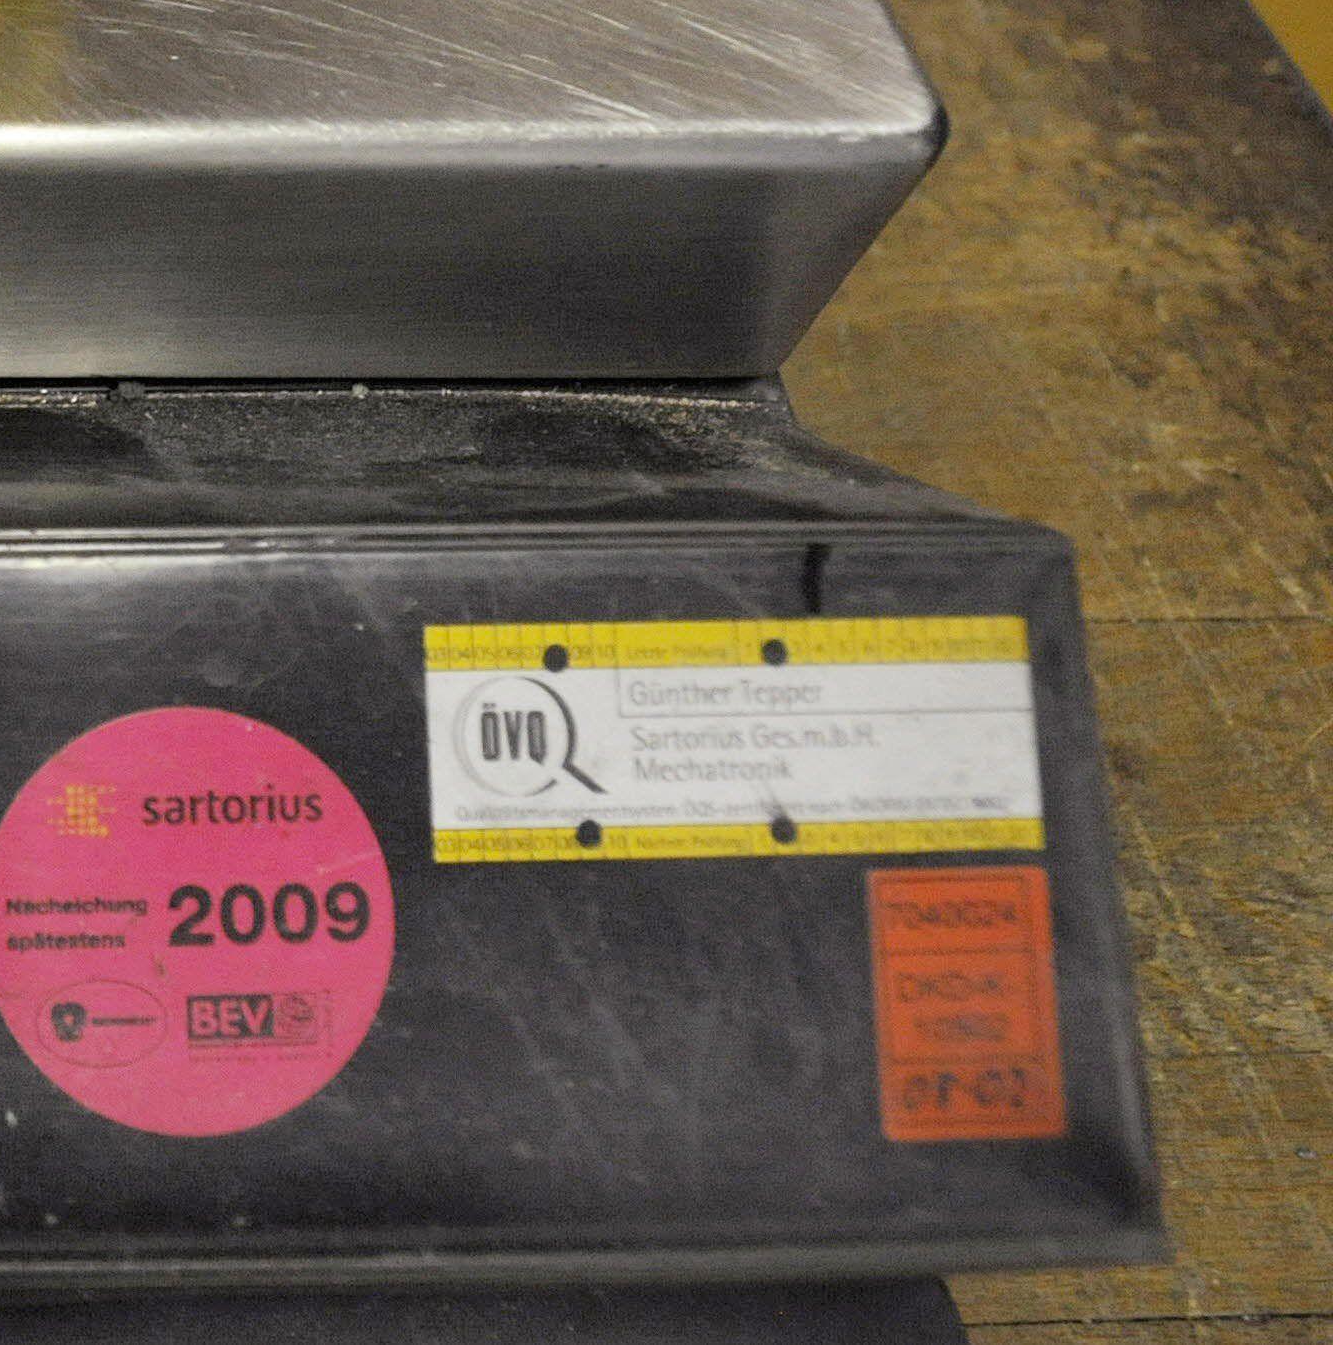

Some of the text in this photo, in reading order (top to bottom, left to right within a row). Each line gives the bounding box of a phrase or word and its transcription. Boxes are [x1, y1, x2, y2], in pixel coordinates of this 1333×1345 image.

[629, 725, 745, 752] Sartorius
[633, 756, 794, 784] Mechatronik
[142, 784, 324, 826] sartorius
[167, 881, 371, 947] 2009
[191, 999, 271, 1036] BEV
